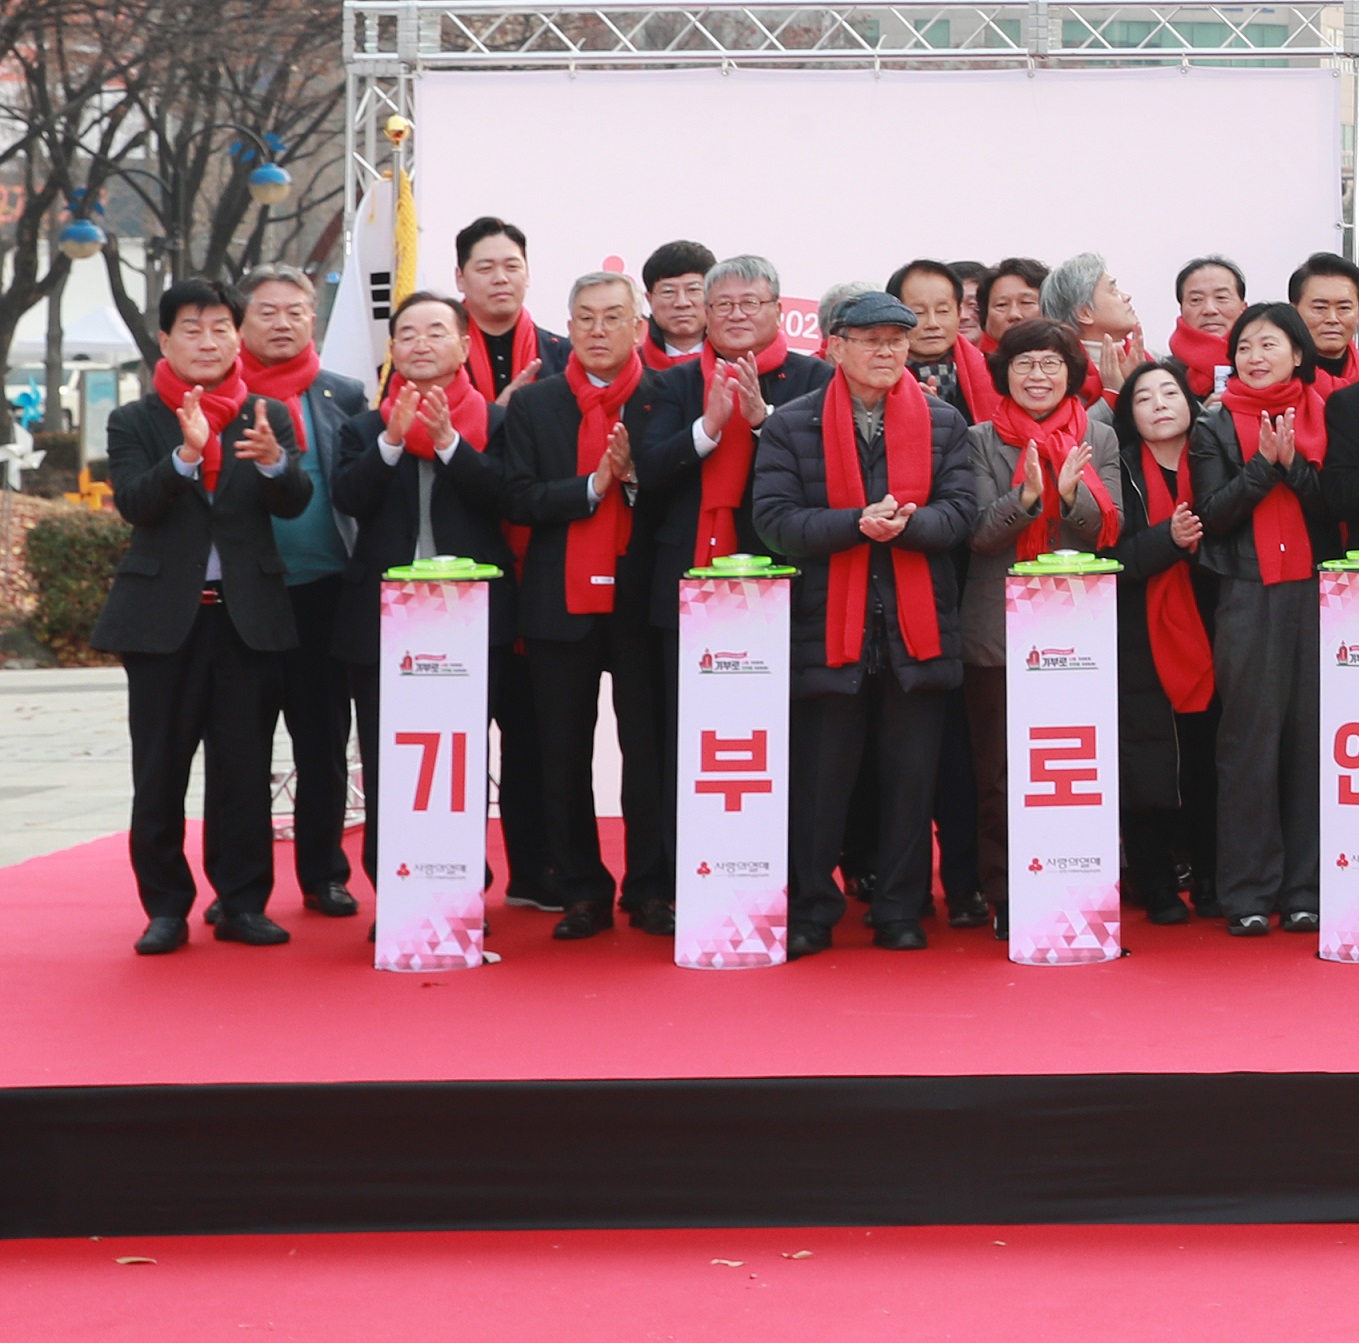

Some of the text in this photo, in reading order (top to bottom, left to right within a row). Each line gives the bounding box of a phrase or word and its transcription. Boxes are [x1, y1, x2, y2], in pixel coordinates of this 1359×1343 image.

[1041, 657, 1067, 667] 기부로
[396, 733, 466, 812] 기
[695, 730, 773, 812] 부
[1024, 725, 1103, 807] 로
[1046, 857, 1101, 869] 사랑의열매
